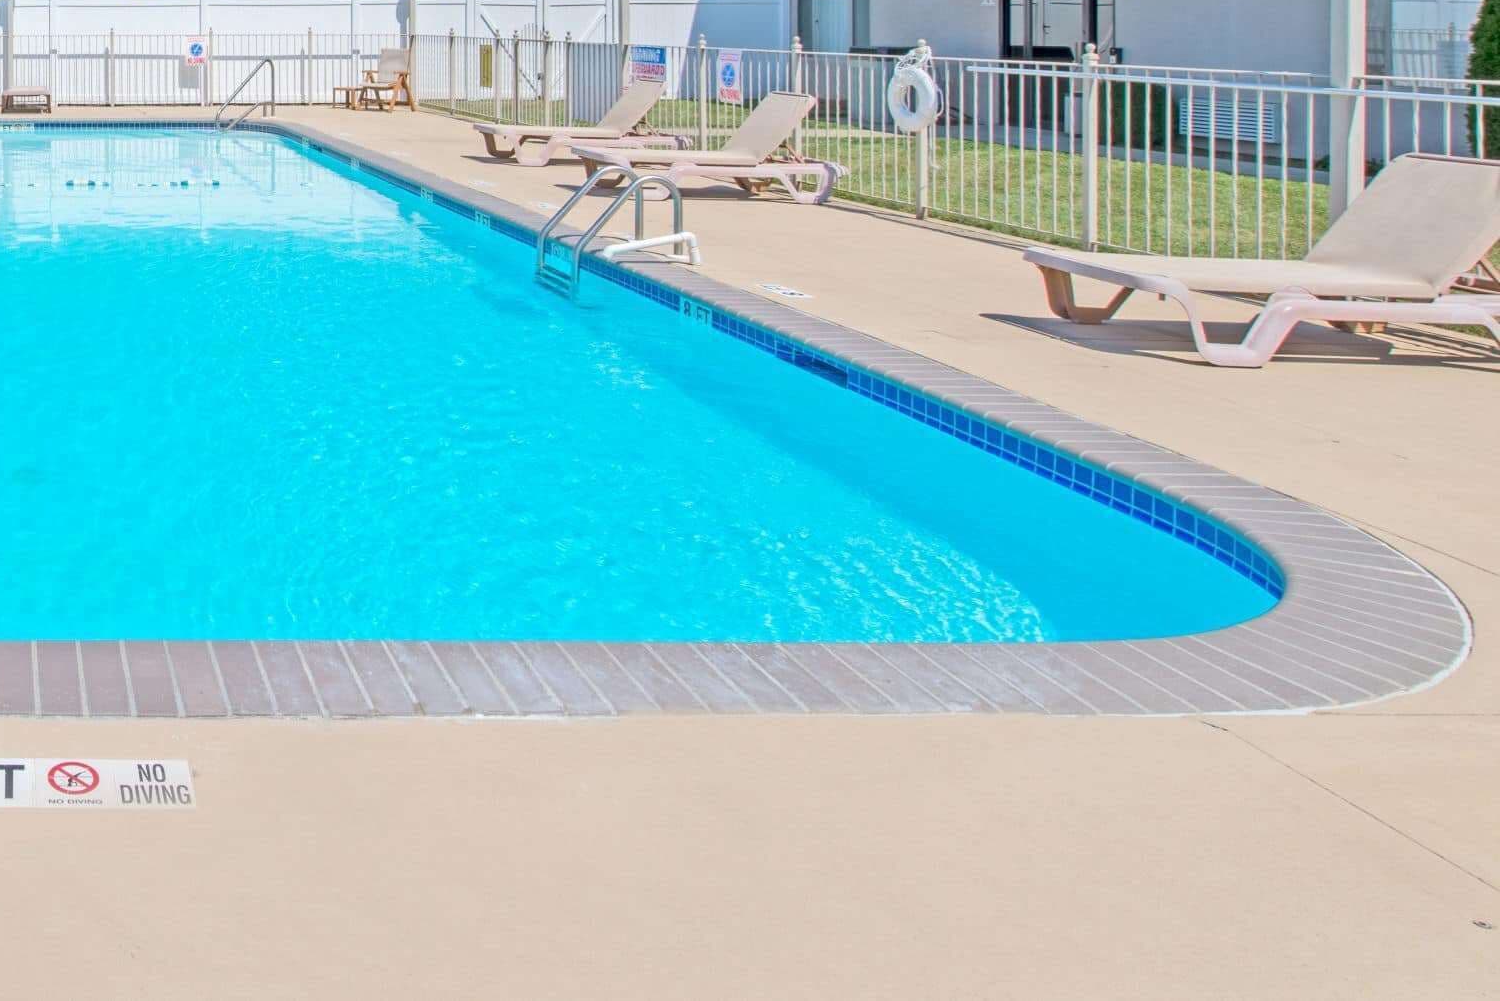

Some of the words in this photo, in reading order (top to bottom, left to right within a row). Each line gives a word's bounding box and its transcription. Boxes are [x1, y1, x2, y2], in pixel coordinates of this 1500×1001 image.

[696, 306, 710, 326] FT
[137, 763, 167, 782] NO
[119, 784, 192, 805] DIVING
